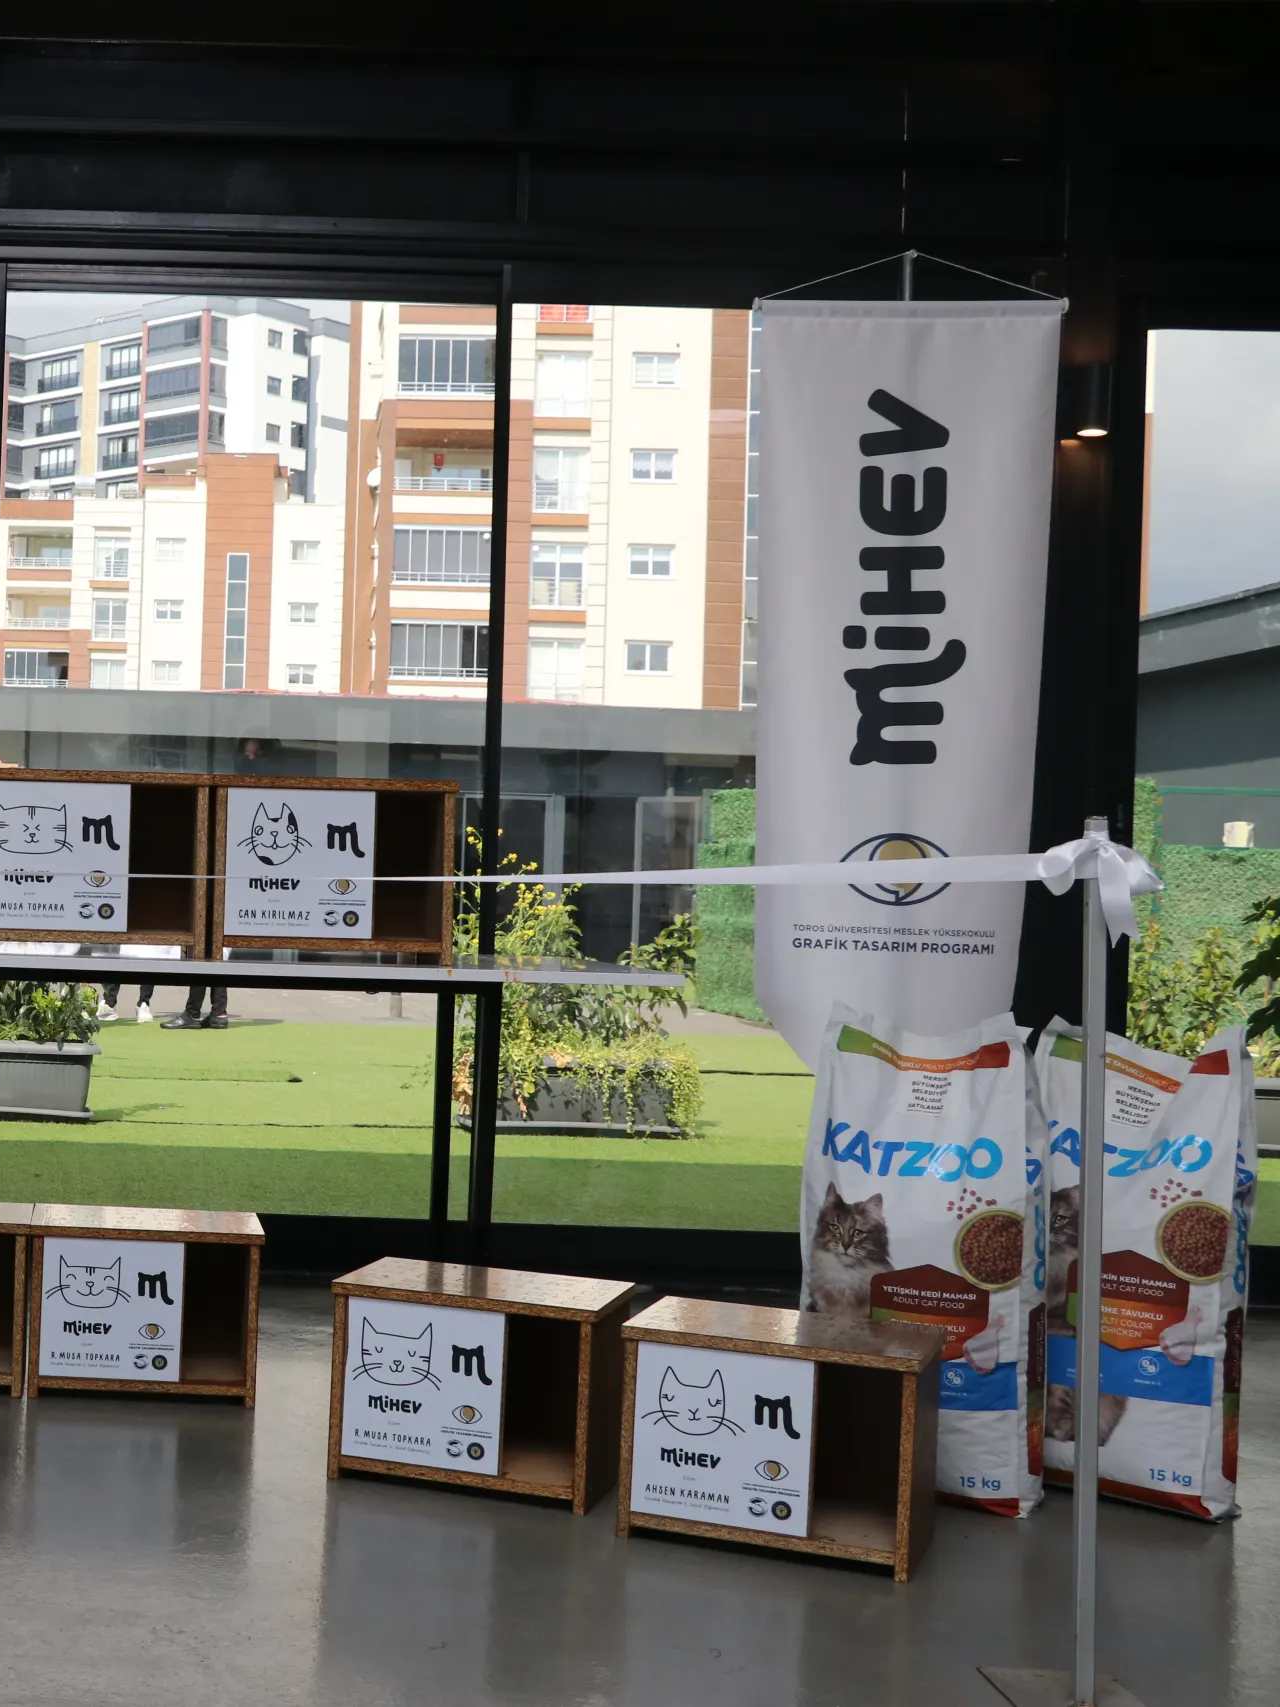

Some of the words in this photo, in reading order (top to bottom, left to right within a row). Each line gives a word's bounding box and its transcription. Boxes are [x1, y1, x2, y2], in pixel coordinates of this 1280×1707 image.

[1, 902, 23, 910] MUSA
[28, 903, 65, 911] TOPKARA
[238, 909, 257, 918] CAN
[261, 910, 310, 920] KIRILMAZ
[793, 924, 825, 932] TOROS
[827, 924, 891, 935] ÜNİVERSİTESİ
[894, 927, 930, 936] MESLEK
[933, 928, 995, 938] YÜKSEKOKULU
[792, 937, 848, 950] GRAFİK
[852, 940, 917, 953] TASARIM
[921, 942, 994, 955] PROGRAMI
[822, 1118, 1002, 1182] KATZOO
[1048, 1120, 1213, 1177] AZOO
[1101, 1282, 1117, 1290] ULT
[1138, 1287, 1164, 1297] FOOD
[1120, 1276, 1140, 1284] KEDİ
[1141, 1279, 1176, 1289] MAMASI
[883, 1285, 919, 1295] YETİŞKİN
[921, 1290, 940, 1298] KEDİ
[893, 1296, 919, 1305] ADULT
[1101, 1305, 1118, 1314] RME
[1121, 1309, 1164, 1320] TAVUKLU
[1120, 1319, 1153, 1330] COLOR
[1101, 1326, 1141, 1338] CHICKEN
[59, 1352, 81, 1360] MUSA
[85, 1353, 120, 1362] TOPKARA
[364, 1430, 388, 1441] MUSA
[393, 1434, 432, 1447] TOPKARA
[959, 1476, 976, 1488] 15
[982, 1477, 1001, 1491] kg
[1149, 1468, 1166, 1482] 15
[1172, 1472, 1193, 1487] kg
[645, 1483, 675, 1496] AHSEN
[680, 1485, 730, 1504] KARAMAN
